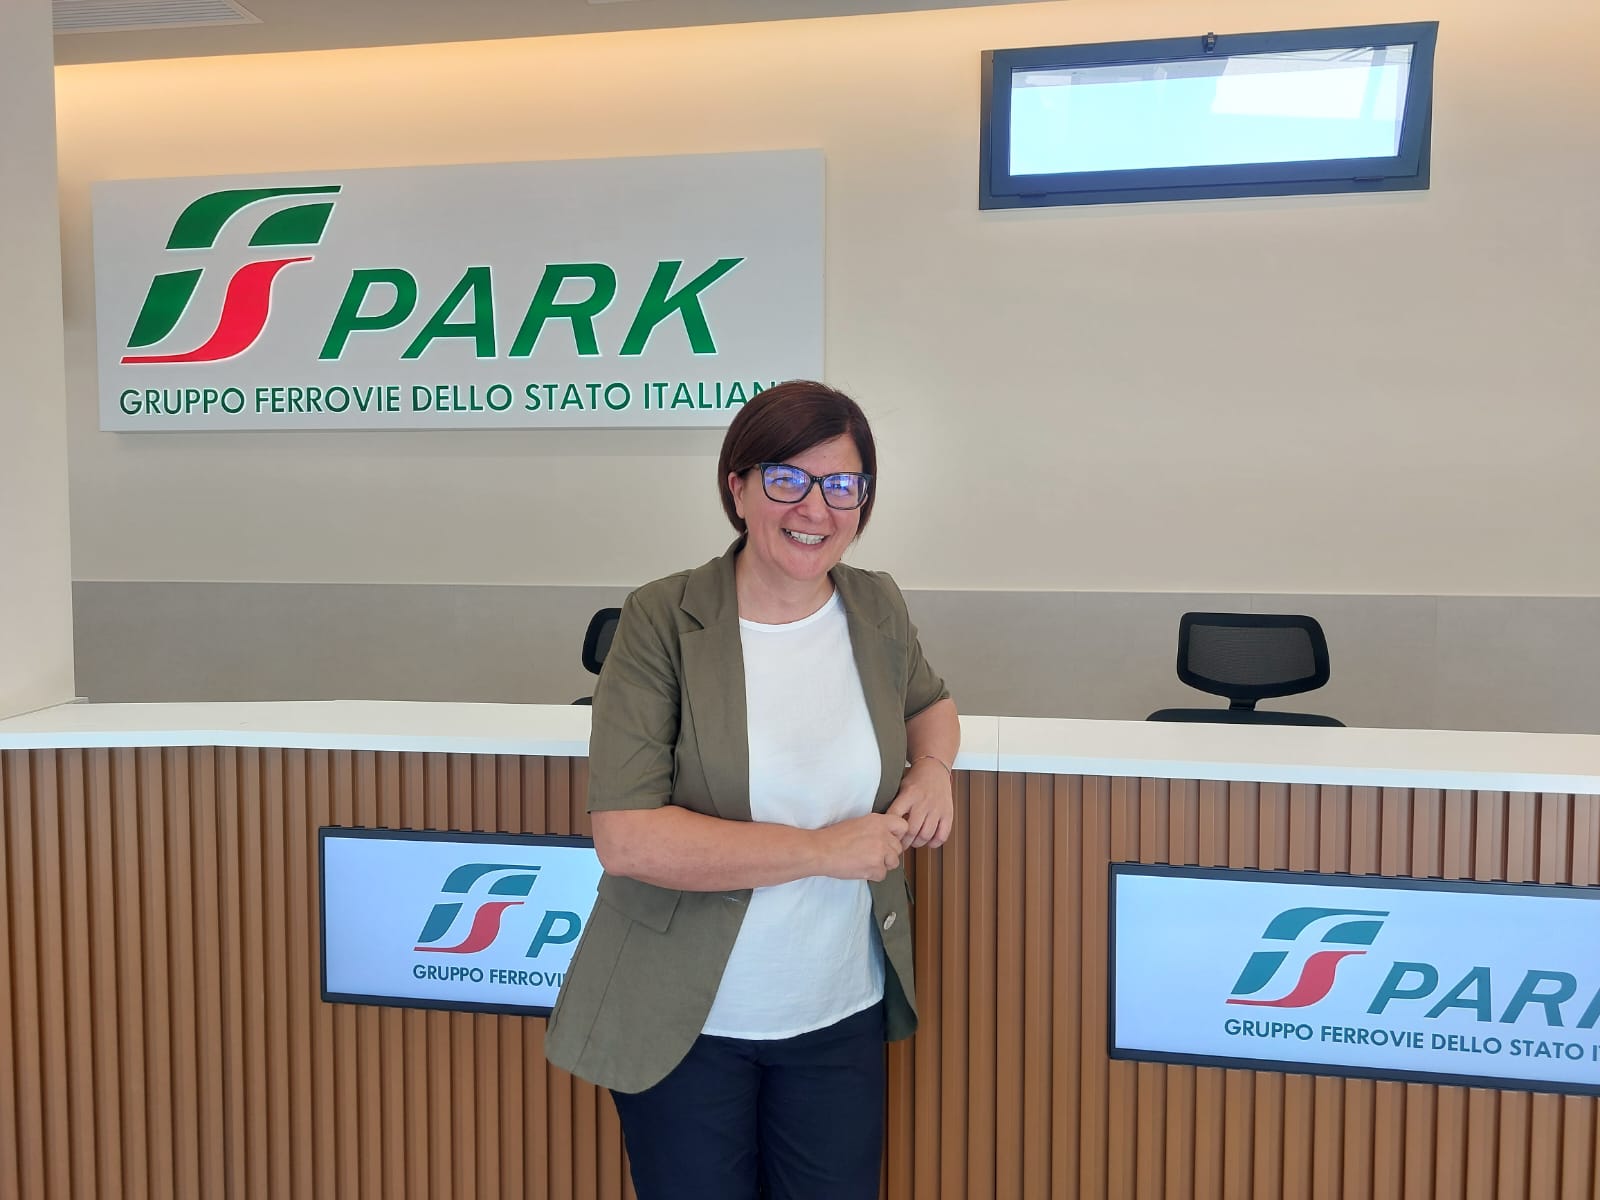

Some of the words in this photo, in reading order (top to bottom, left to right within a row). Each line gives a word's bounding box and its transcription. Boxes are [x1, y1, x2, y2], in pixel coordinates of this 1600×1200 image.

[318, 257, 746, 361] PARK
[119, 386, 246, 416] GRUPPO
[254, 385, 401, 414] FERROVIE
[411, 383, 513, 412] DELLO
[524, 381, 632, 411] STATO
[643, 380, 789, 410] ITALIA
[412, 964, 485, 984] GRUPPO
[489, 967, 566, 988] FERROVI
[1223, 1018, 1314, 1042] GRUPPO
[1320, 1026, 1424, 1050] FERROVIE
[1431, 1034, 1502, 1055] DELLO
[1509, 1039, 1585, 1060] STATO
